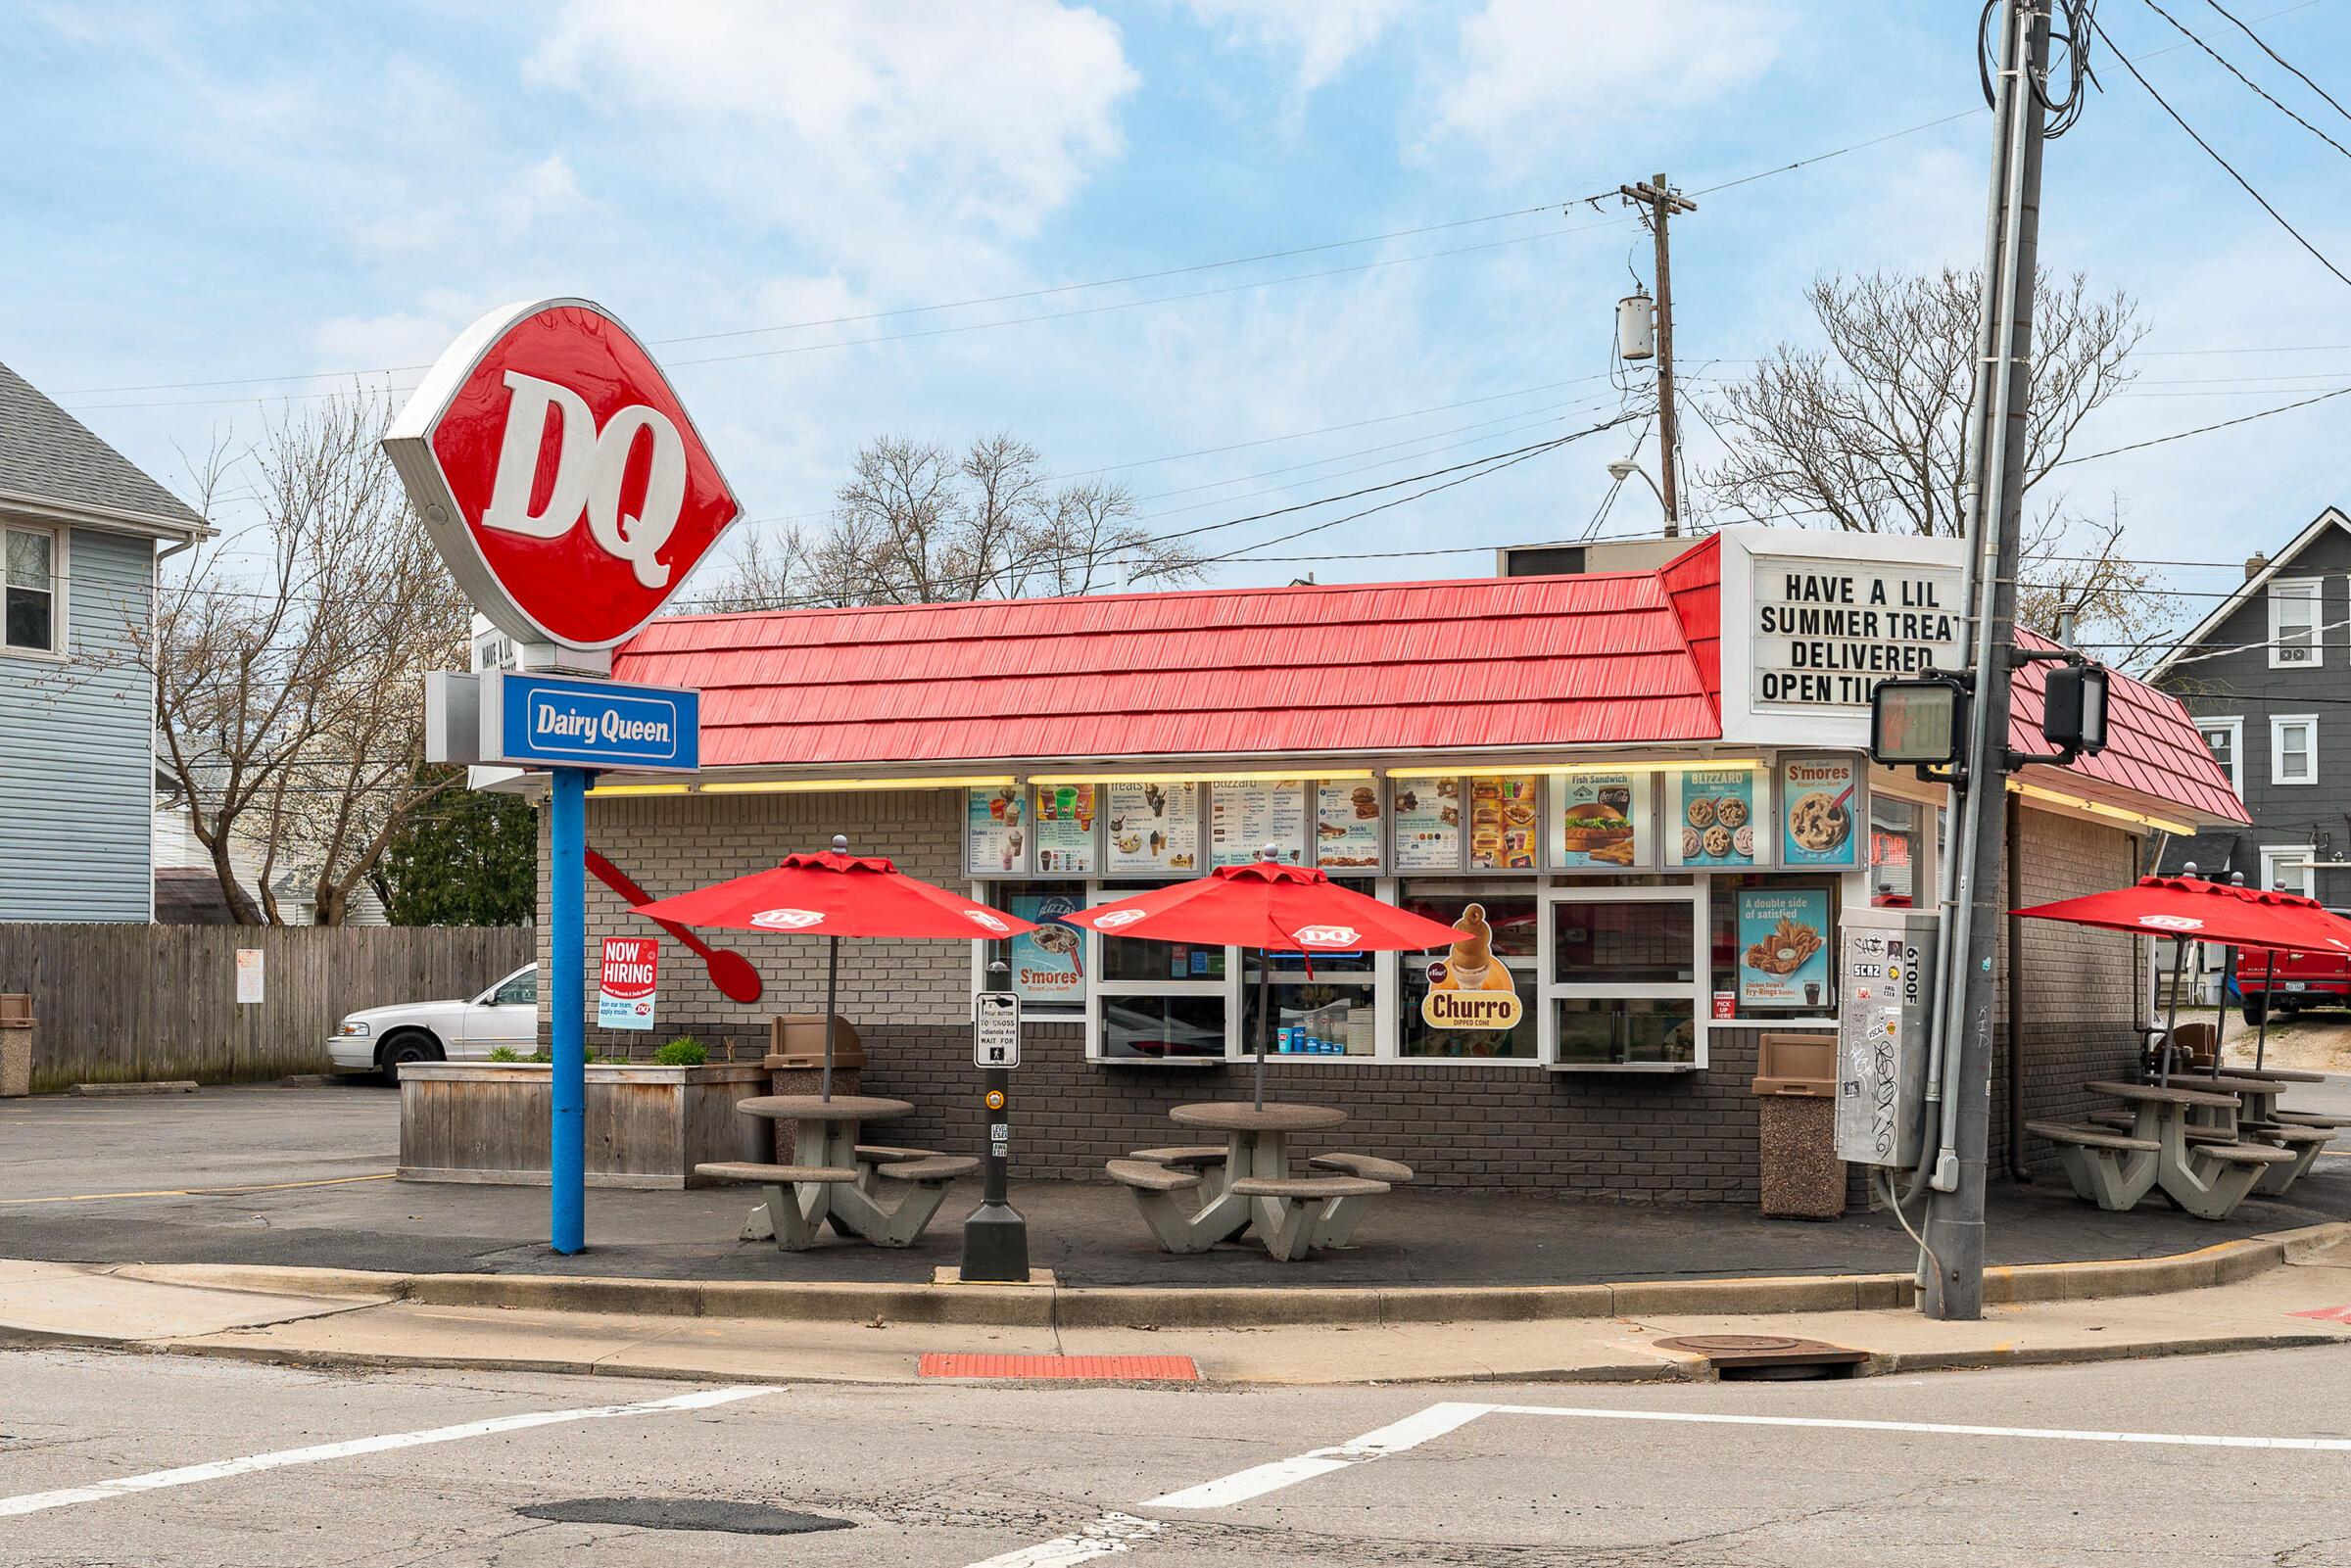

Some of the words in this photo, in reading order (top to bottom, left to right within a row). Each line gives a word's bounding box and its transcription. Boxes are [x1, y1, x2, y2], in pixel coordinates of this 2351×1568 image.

[481, 369, 686, 589] DQ
[1786, 574, 1854, 603] HAVE
[1869, 579, 1887, 605] A
[1901, 581, 1940, 607] LIL
[1761, 606, 1878, 638] SUMMER
[1792, 641, 1933, 673] DELIVERED
[1762, 673, 1832, 702] OPEN
[536, 704, 598, 743] Dairy
[1590, 775, 1627, 784] Sandwich
[1692, 772, 1743, 784] BLIZZARD
[1789, 766, 1849, 781] S'mores
[1746, 900, 1752, 909] A
[1754, 898, 1786, 908] double
[1788, 897, 1807, 907] side
[1746, 910, 1755, 919] of
[1757, 908, 1798, 919] satisfied
[1301, 929, 1353, 942] DQ
[605, 941, 640, 962] NOW
[603, 962, 653, 984] HIRING
[1020, 969, 1078, 984] S'mores
[1428, 968, 1446, 976] New!
[1905, 947, 1919, 1005] 6TOOF
[1746, 988, 1778, 997] Fry-Rings
[1433, 993, 1511, 1019] Churro
